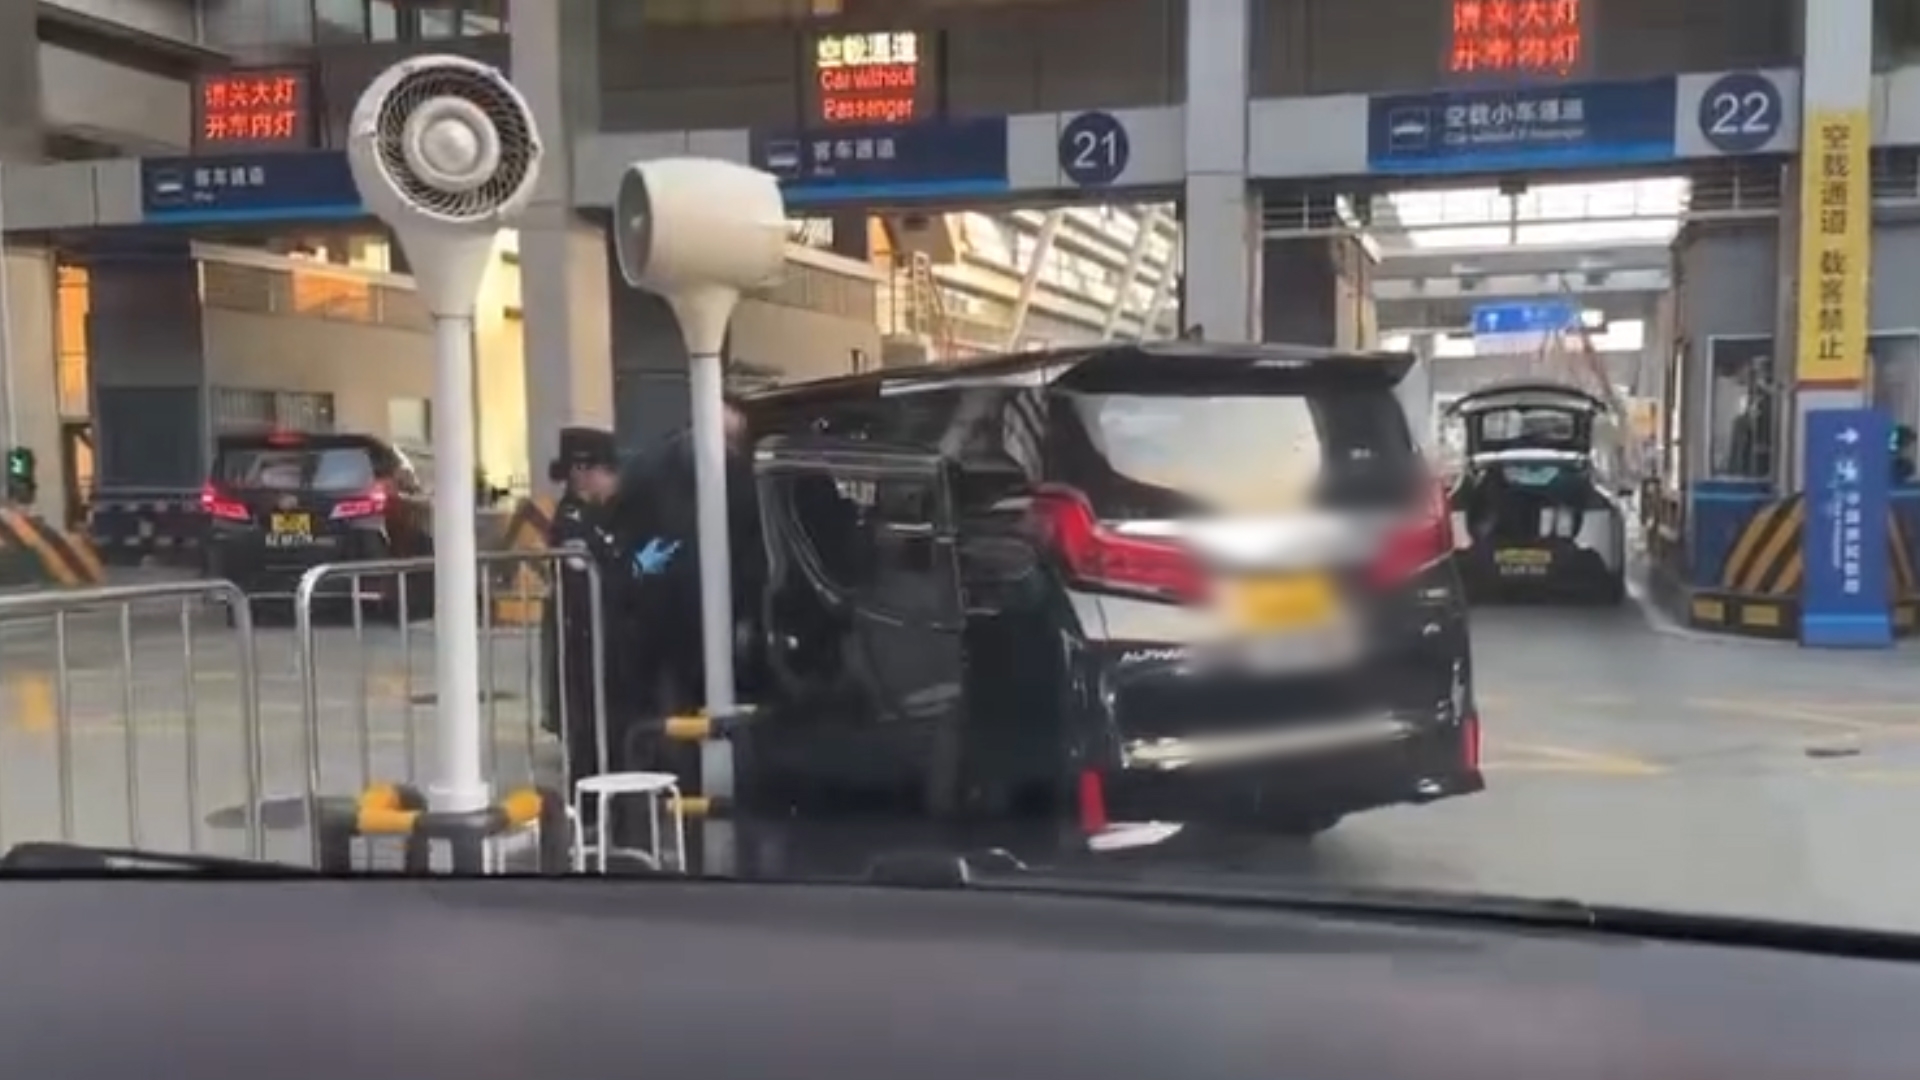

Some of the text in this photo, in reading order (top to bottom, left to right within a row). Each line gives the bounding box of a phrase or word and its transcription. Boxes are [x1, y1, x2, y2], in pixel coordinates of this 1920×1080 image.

[1711, 92, 1770, 134] 22
[1073, 130, 1116, 168] 21
[1817, 124, 1850, 360] 空载通道 载客禁止
